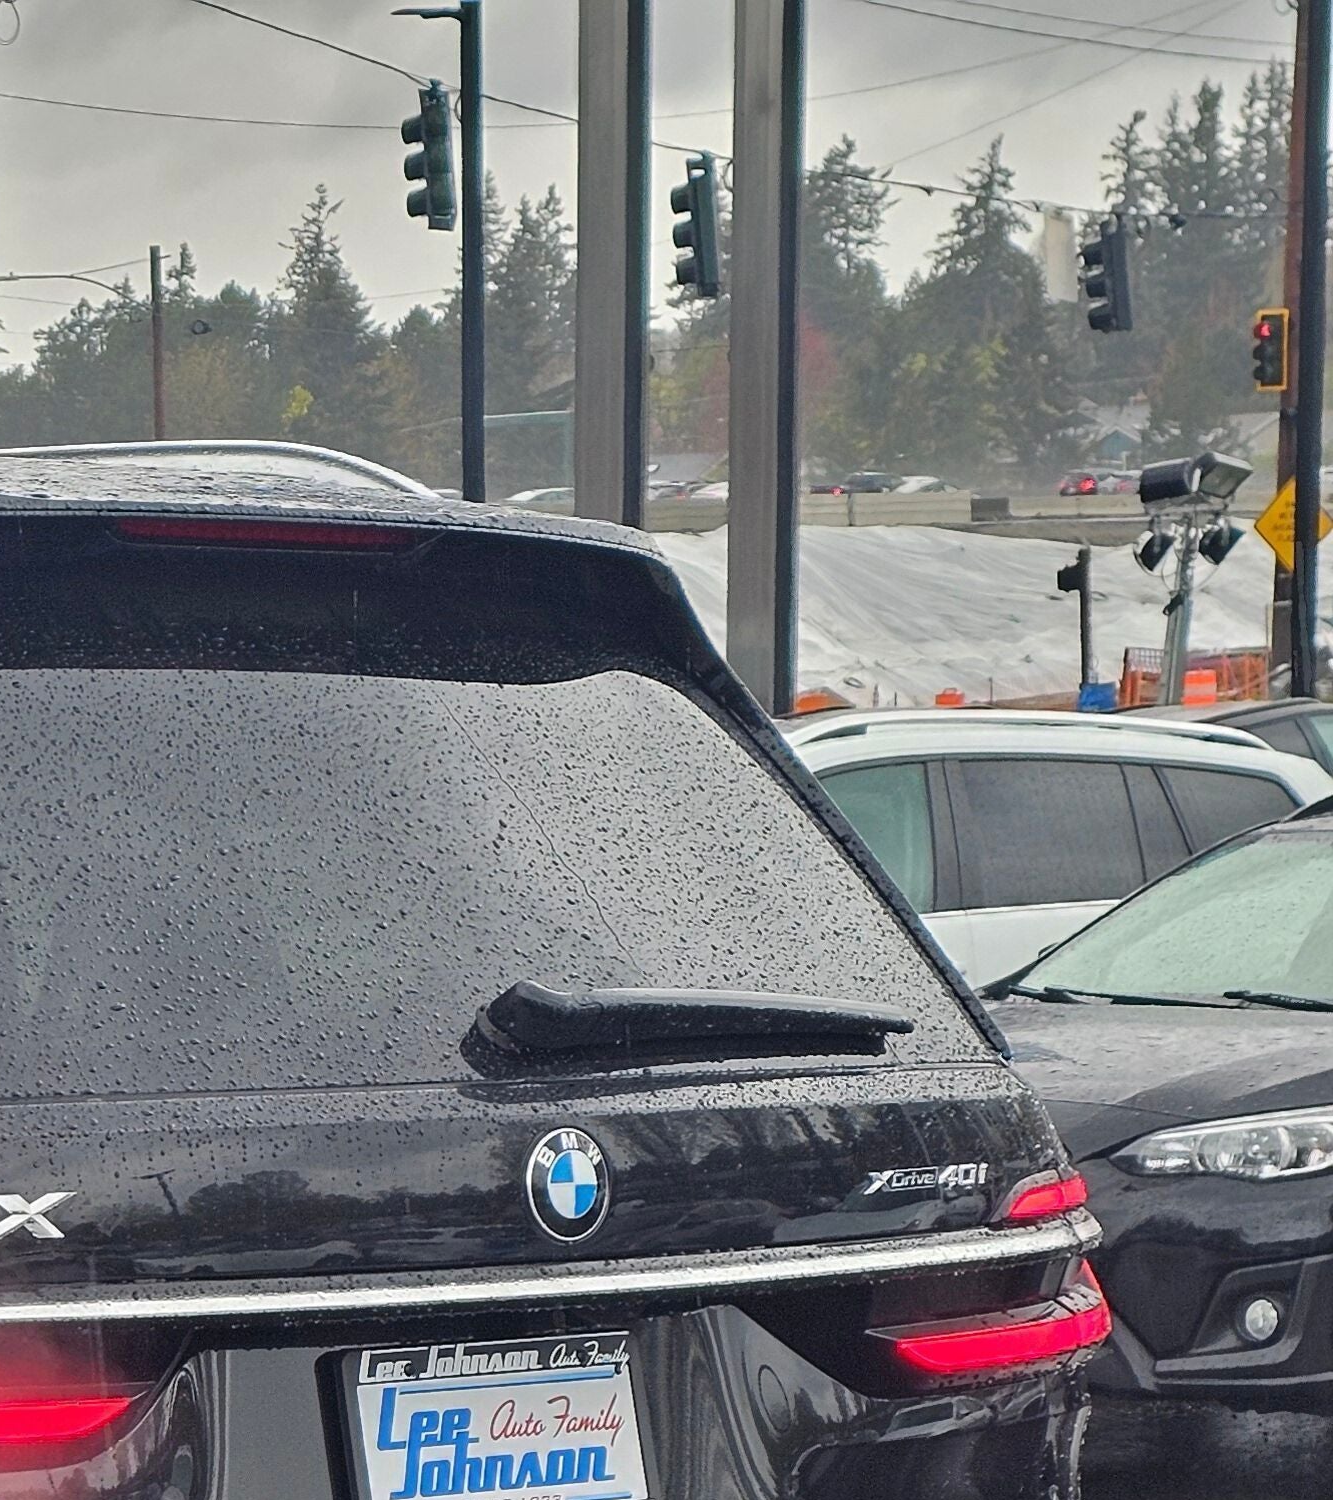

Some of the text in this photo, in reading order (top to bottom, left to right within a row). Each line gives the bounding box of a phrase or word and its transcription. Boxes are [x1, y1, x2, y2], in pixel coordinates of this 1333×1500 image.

[536, 1132, 602, 1168] BMW
[359, 1350, 416, 1383] Lee
[419, 1343, 543, 1379] Johnson
[583, 1339, 630, 1371] Family
[377, 1387, 479, 1451] Lee
[490, 1393, 625, 1446] Auto Family
[389, 1430, 616, 1500] Johnson
